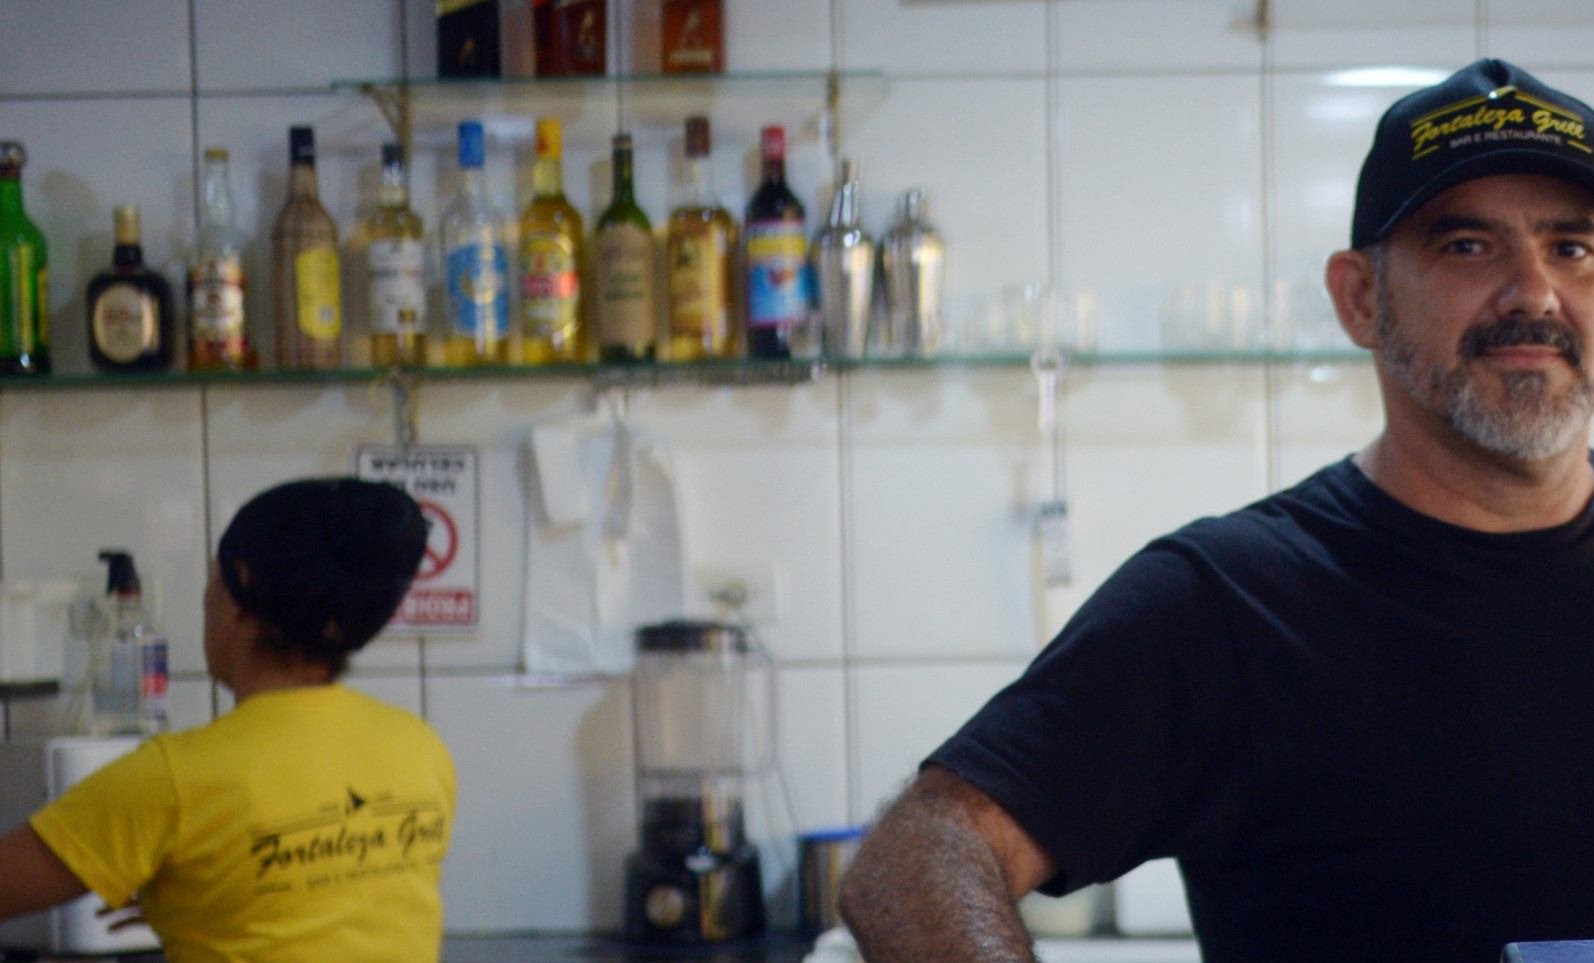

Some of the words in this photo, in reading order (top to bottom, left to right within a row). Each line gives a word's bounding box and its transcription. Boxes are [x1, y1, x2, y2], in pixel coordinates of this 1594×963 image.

[1411, 105, 1525, 151] Fortaleza
[1532, 110, 1585, 140] Grill
[1450, 135, 1472, 149] BAR
[1473, 133, 1482, 143] E
[1484, 130, 1563, 146] RESTAURANTE
[251, 824, 386, 879] Fortaleza
